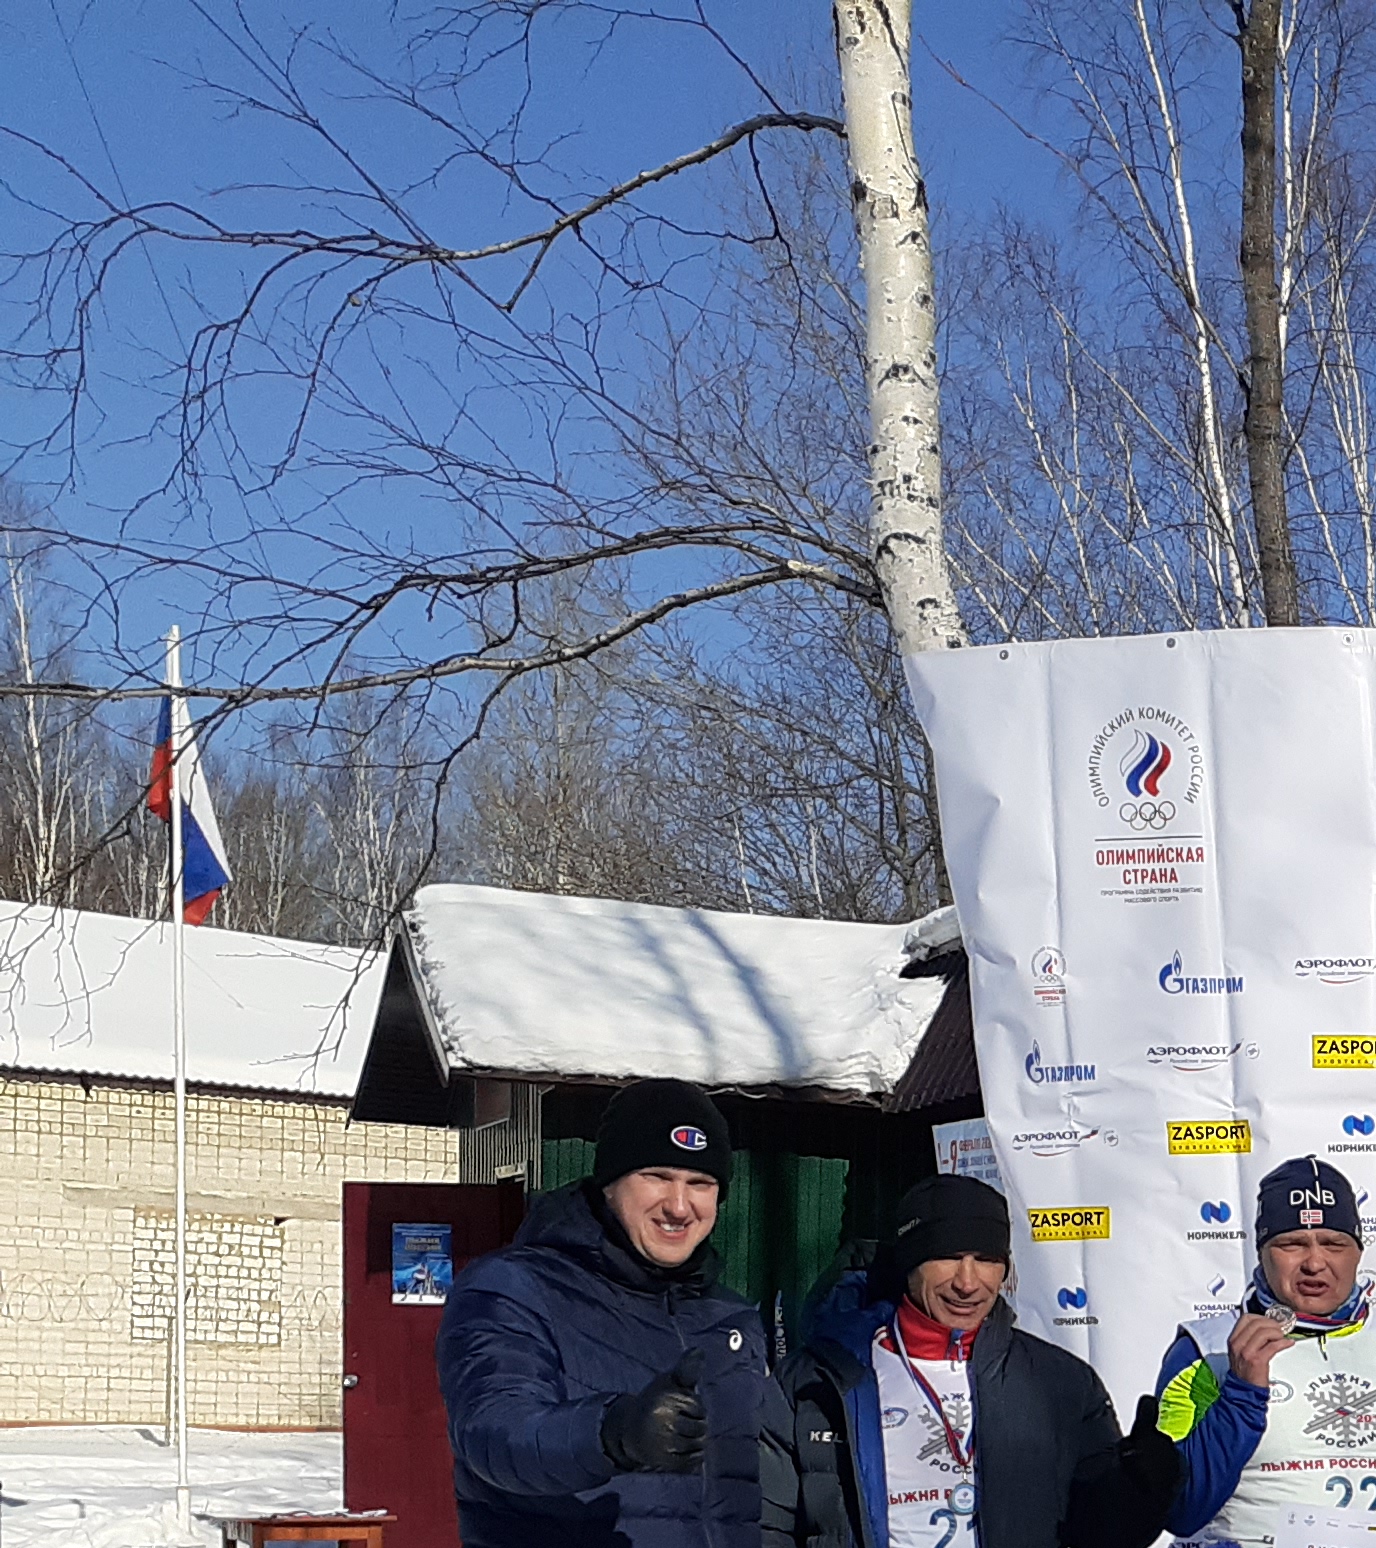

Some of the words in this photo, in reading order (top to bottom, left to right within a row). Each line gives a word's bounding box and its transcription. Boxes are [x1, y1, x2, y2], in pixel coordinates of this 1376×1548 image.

[1088, 708, 1135, 807] ОЛИМПИЙСКИЙ
[1138, 706, 1195, 743] КОМИТЕТ
[1183, 745, 1204, 804] РОССИИ
[1095, 844, 1205, 866] ОЛИМПИЙСКАЯ
[1122, 867, 1179, 885] СТРАНА
[1294, 958, 1375, 969] АЭРОФЛОТ
[1146, 1046, 1230, 1056] АЭРОФЛОТ
[1012, 1132, 1080, 1143] АЭРОФЛОТ
[1171, 1124, 1247, 1141] ZASPORT
[1290, 1181, 1336, 1210] DNB
[1030, 1212, 1104, 1227] ZASPORT
[1187, 1231, 1247, 1240] НОРНИКЕЛЬ
[1309, 1373, 1372, 1392] ЛЫЖНЯ
[929, 1457, 974, 1475] РОСС
[1261, 1459, 1325, 1472] ЛЫЖНЯ
[887, 1489, 939, 1505] ЫЖНЯ
